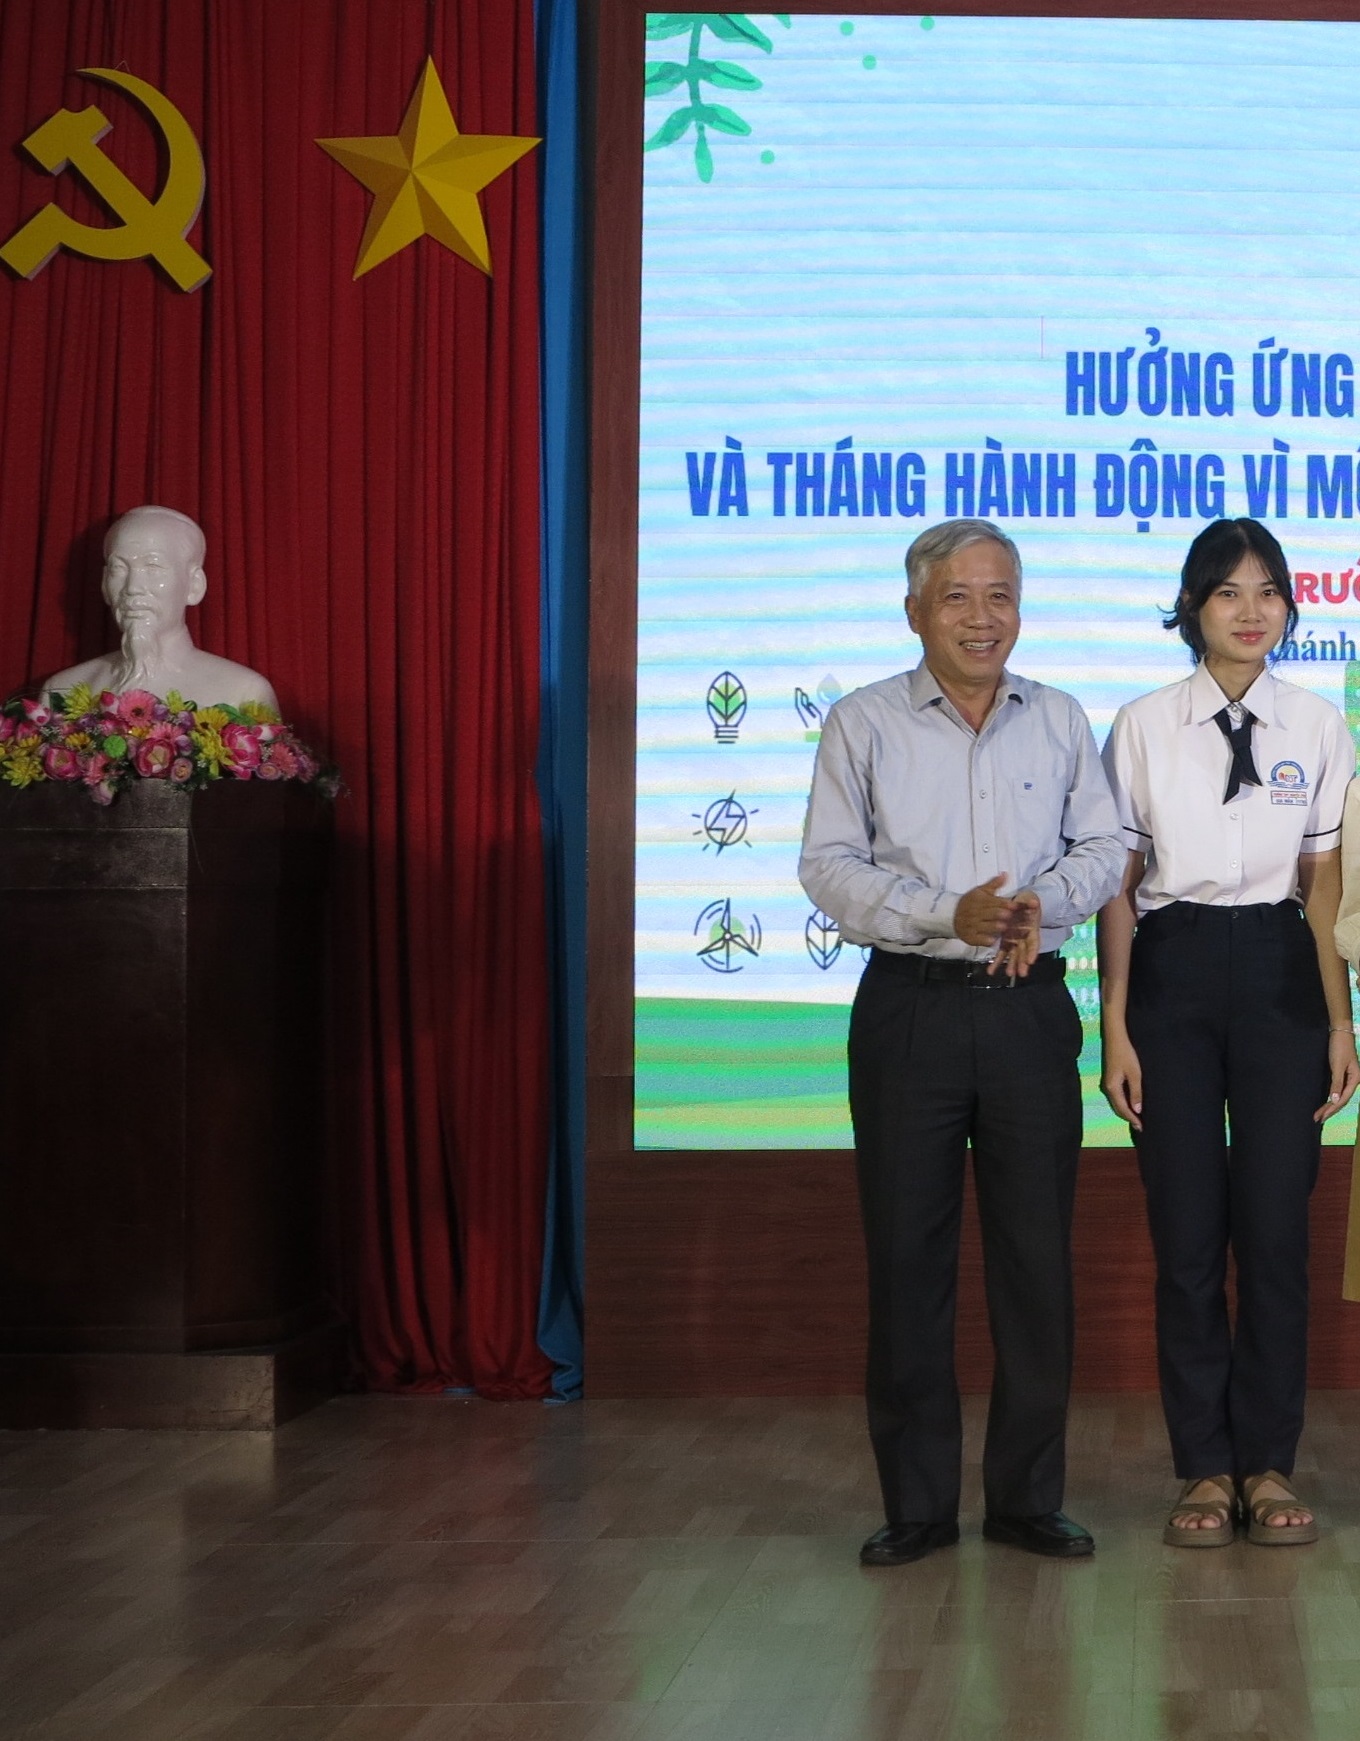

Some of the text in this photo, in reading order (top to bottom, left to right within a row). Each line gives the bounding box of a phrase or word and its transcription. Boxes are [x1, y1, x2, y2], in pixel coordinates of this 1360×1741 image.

[1066, 327, 1233, 416] HƯỞNG
[1253, 337, 1354, 417] ỨNG
[686, 435, 749, 517] VÀ
[767, 435, 925, 517] THÁNG
[946, 437, 1075, 518] HÀNH
[1093, 437, 1224, 533] ĐỘNG
[1243, 438, 1289, 519] VÌ
